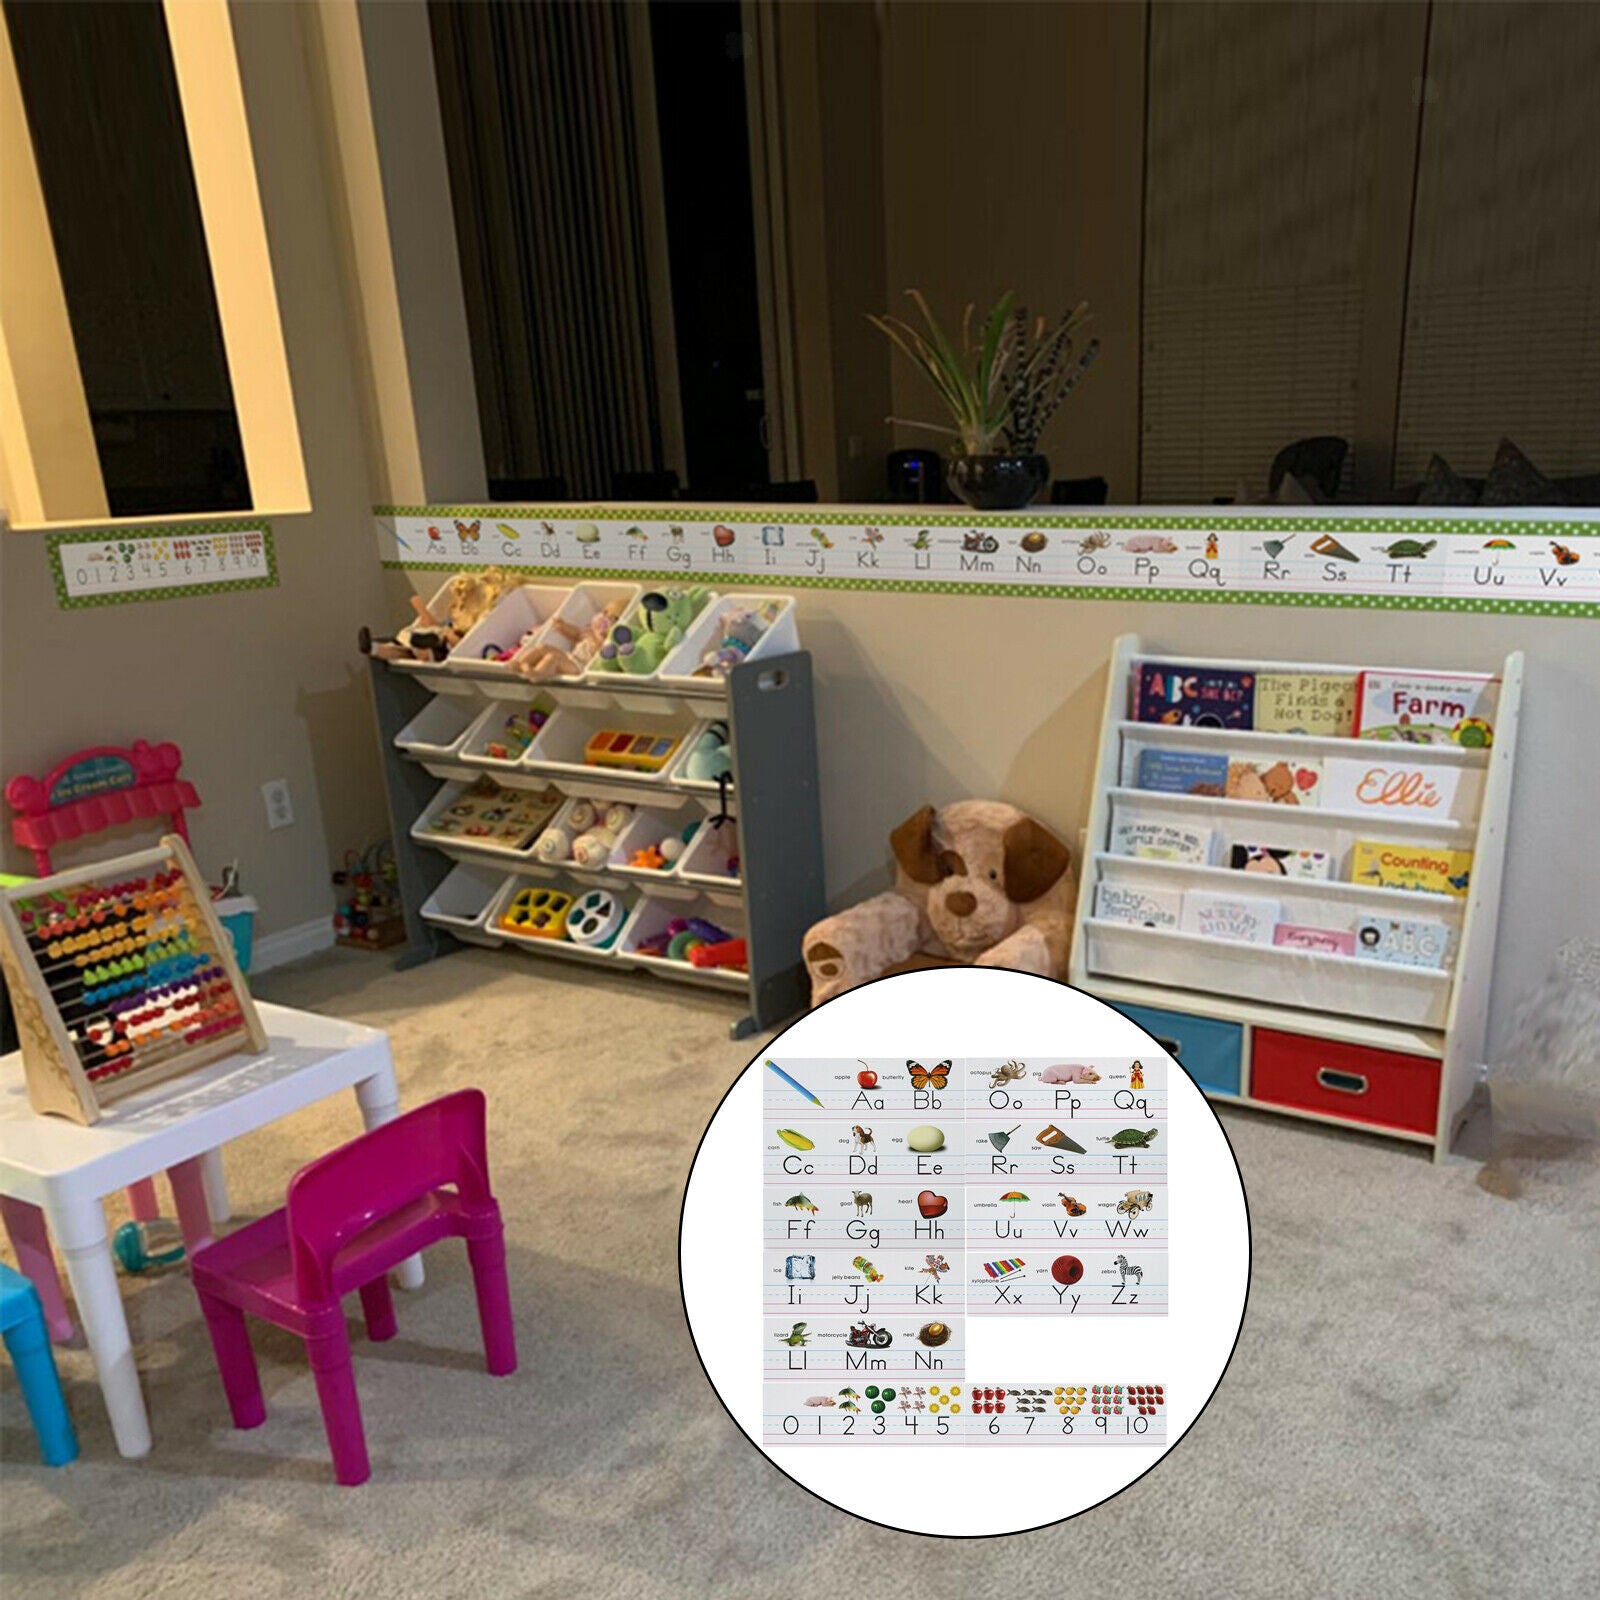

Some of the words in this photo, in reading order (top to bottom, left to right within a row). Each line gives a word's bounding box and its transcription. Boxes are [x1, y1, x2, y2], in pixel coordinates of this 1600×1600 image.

[76, 568, 88, 585] 0
[110, 565, 119, 582] 2
[126, 565, 135, 581] 3
[159, 562, 168, 577] 5
[184, 560, 192, 575] 6
[502, 541, 522, 557] Cc
[541, 542, 560, 558] Dd
[582, 543, 600, 559] Ee
[629, 544, 646, 561] Ff
[666, 546, 691, 568] Gg
[712, 547, 735, 563] Hh
[763, 548, 777, 565] Ii
[805, 549, 826, 574] Jj
[857, 551, 880, 569] Kk
[914, 552, 931, 570] Ll
[960, 554, 994, 571] Mm
[1016, 555, 1042, 573] Nn
[1077, 556, 1108, 575] Oo
[1134, 557, 1160, 584] Pp
[1188, 558, 1226, 587] Qq
[1263, 561, 1291, 580] Rr
[1322, 562, 1347, 581] Ss
[1386, 564, 1412, 583] Tt
[1474, 566, 1505, 585] Uu
[1539, 568, 1567, 587] Vv
[1149, 672, 1198, 703] ABC
[1260, 678, 1292, 691] The
[1299, 677, 1359, 695] Pigeo
[1275, 693, 1329, 707] Finds
[1334, 697, 1345, 707] a
[1392, 690, 1466, 718] Farm
[1311, 709, 1352, 725] Dog!
[1355, 768, 1442, 808] Ellie
[1380, 851, 1450, 876] Counting
[1101, 886, 1146, 910] baby
[1384, 931, 1434, 957] ABC
